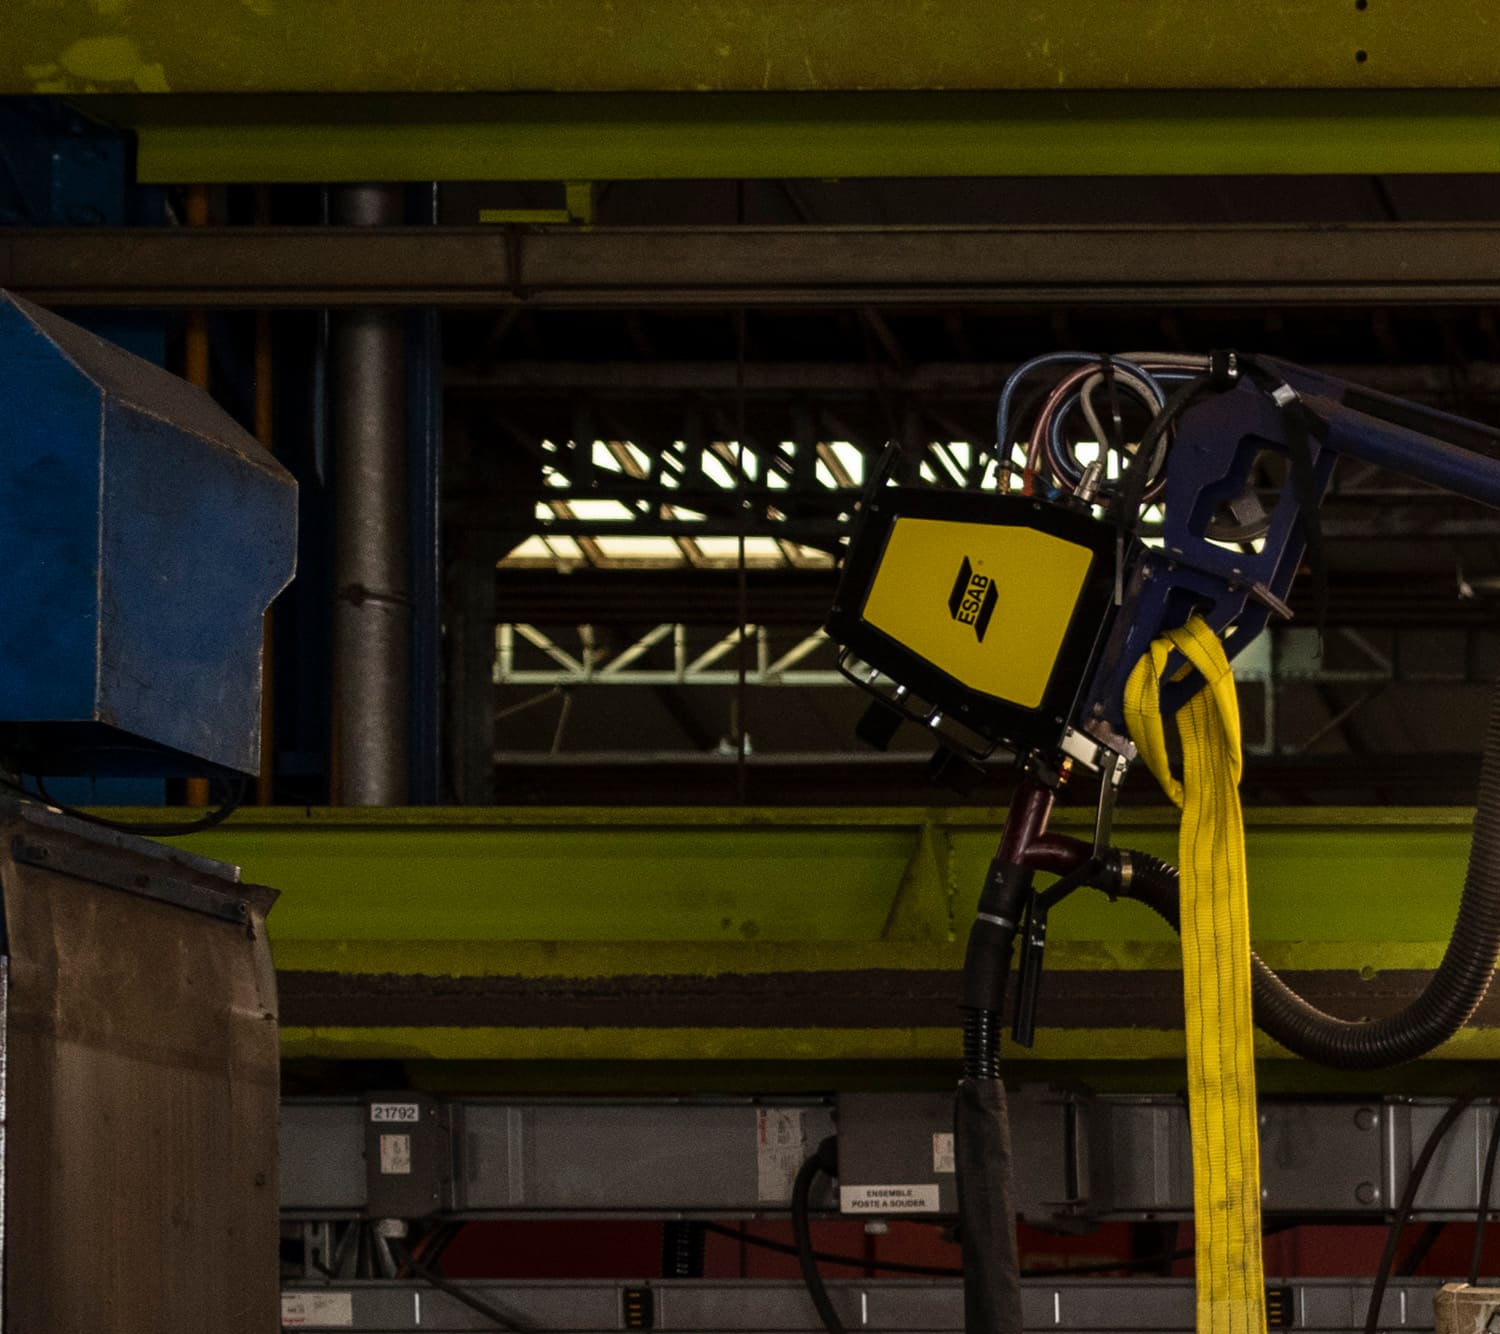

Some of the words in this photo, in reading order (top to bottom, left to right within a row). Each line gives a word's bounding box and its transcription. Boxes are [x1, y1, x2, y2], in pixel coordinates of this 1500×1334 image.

[957, 573, 989, 626] ESAB
[374, 1106, 416, 1121] 21792
[866, 1189, 913, 1198] ENSEMBLE
